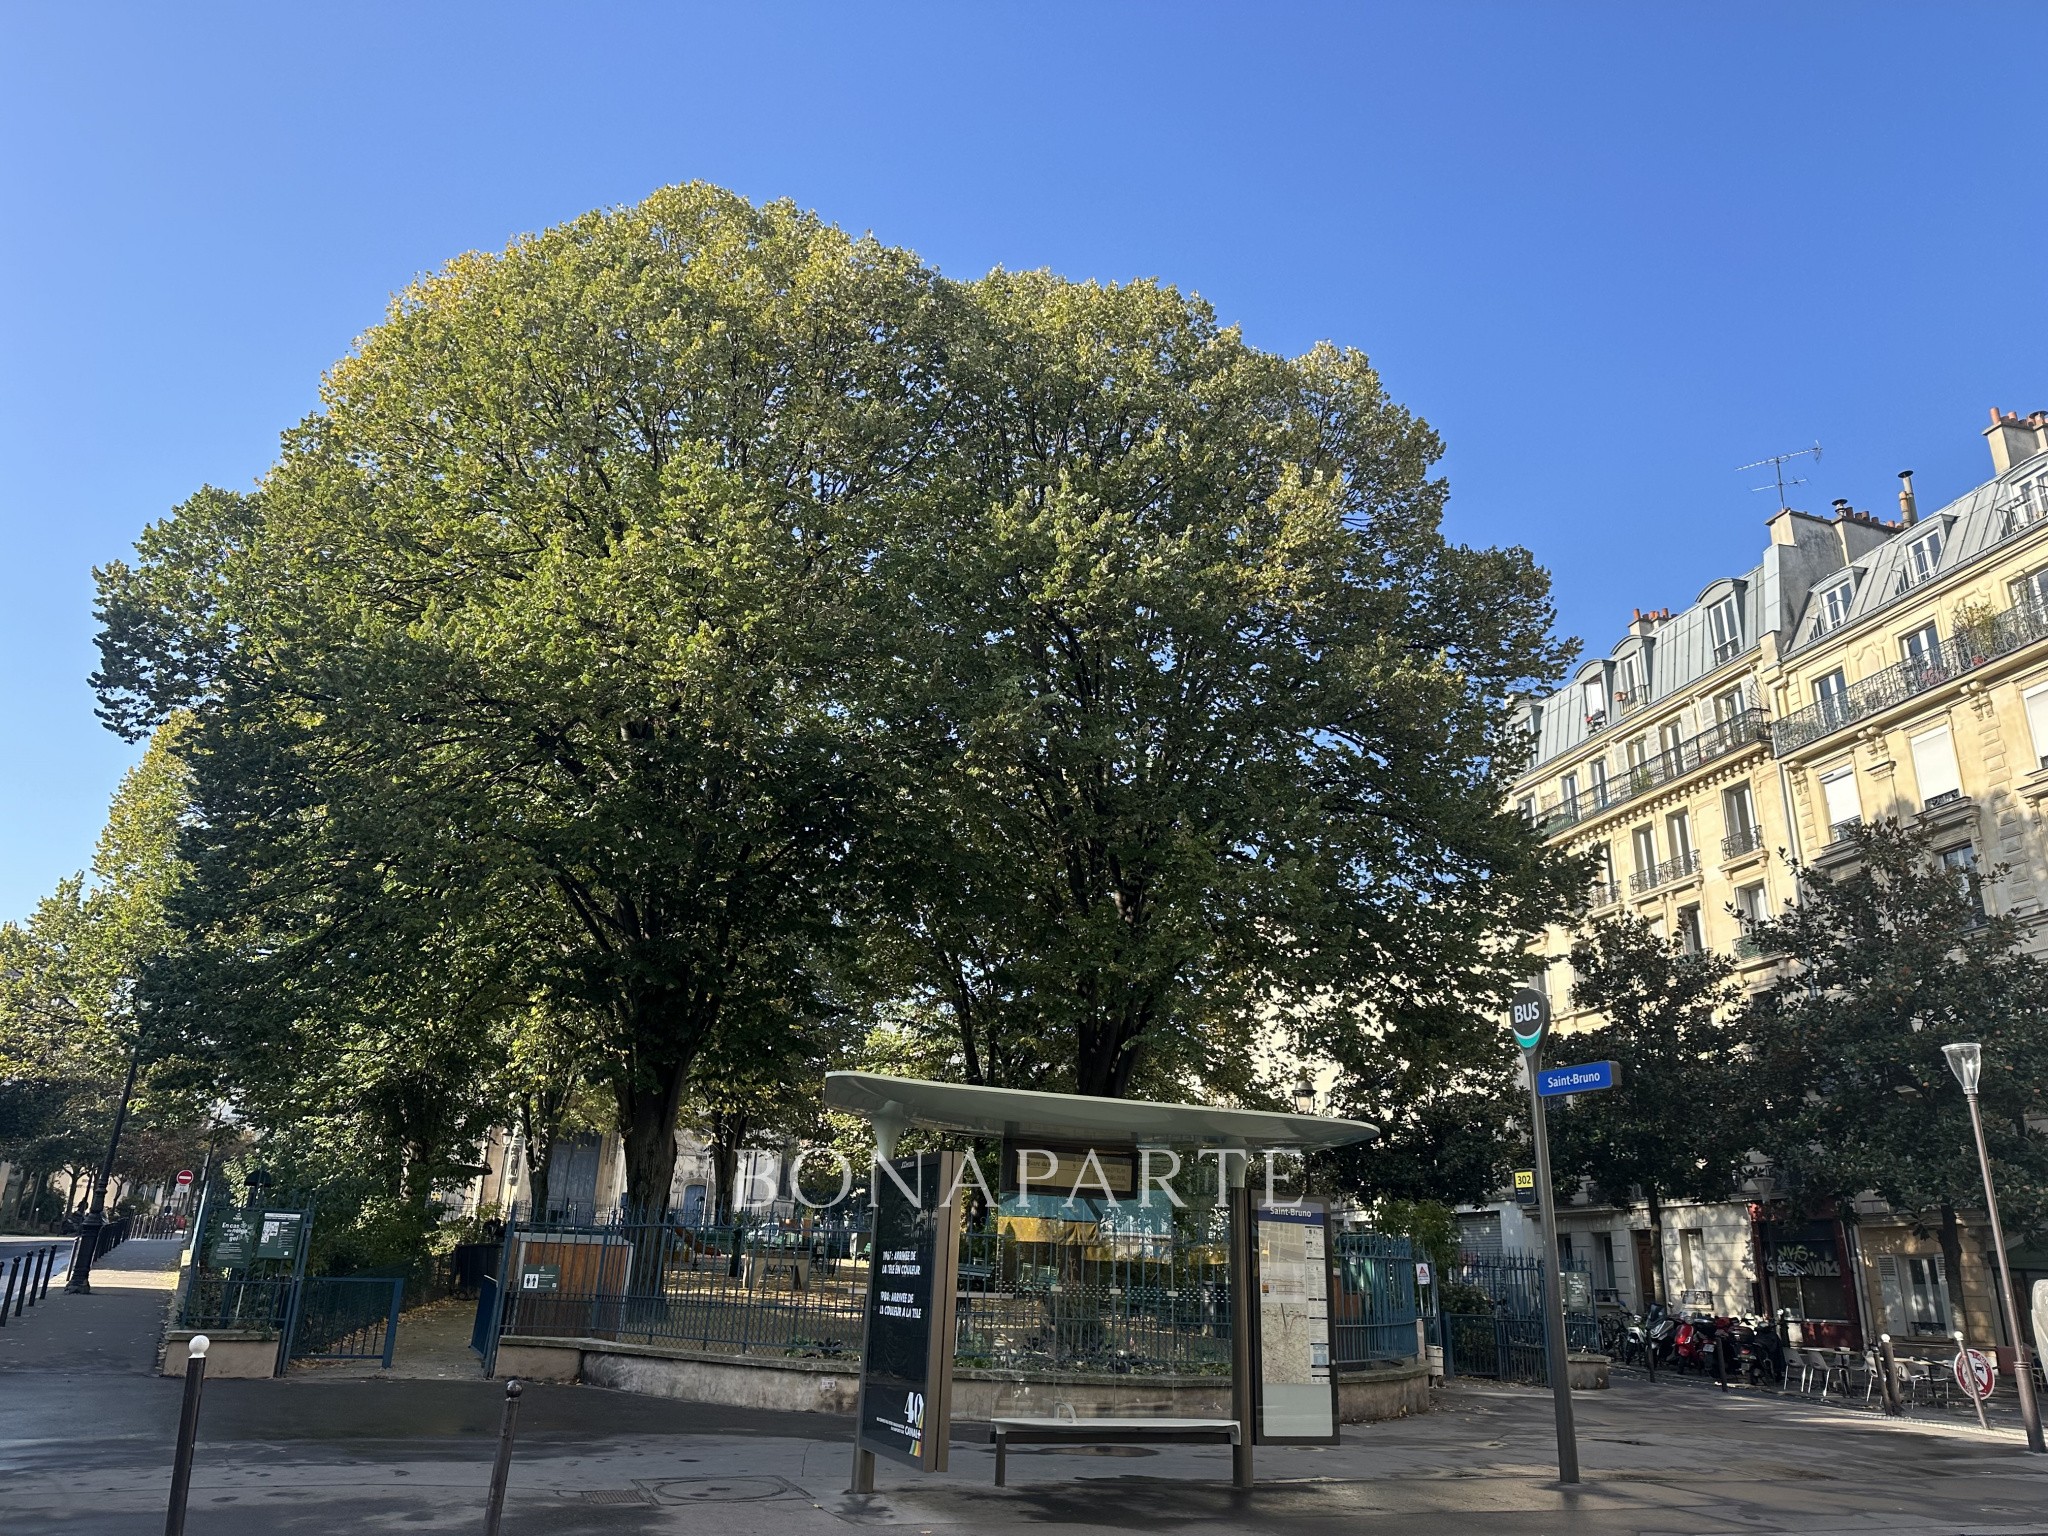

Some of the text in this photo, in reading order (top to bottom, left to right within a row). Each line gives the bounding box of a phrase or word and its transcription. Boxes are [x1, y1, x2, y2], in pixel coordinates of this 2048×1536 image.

[1514, 1001, 1540, 1023] BUS
[1547, 1072, 1601, 1088] Saint-Bruno
[1517, 1175, 1532, 1185] 302
[1270, 1206, 1312, 1218] Saint-Bruno
[904, 1391, 924, 1428] 40
